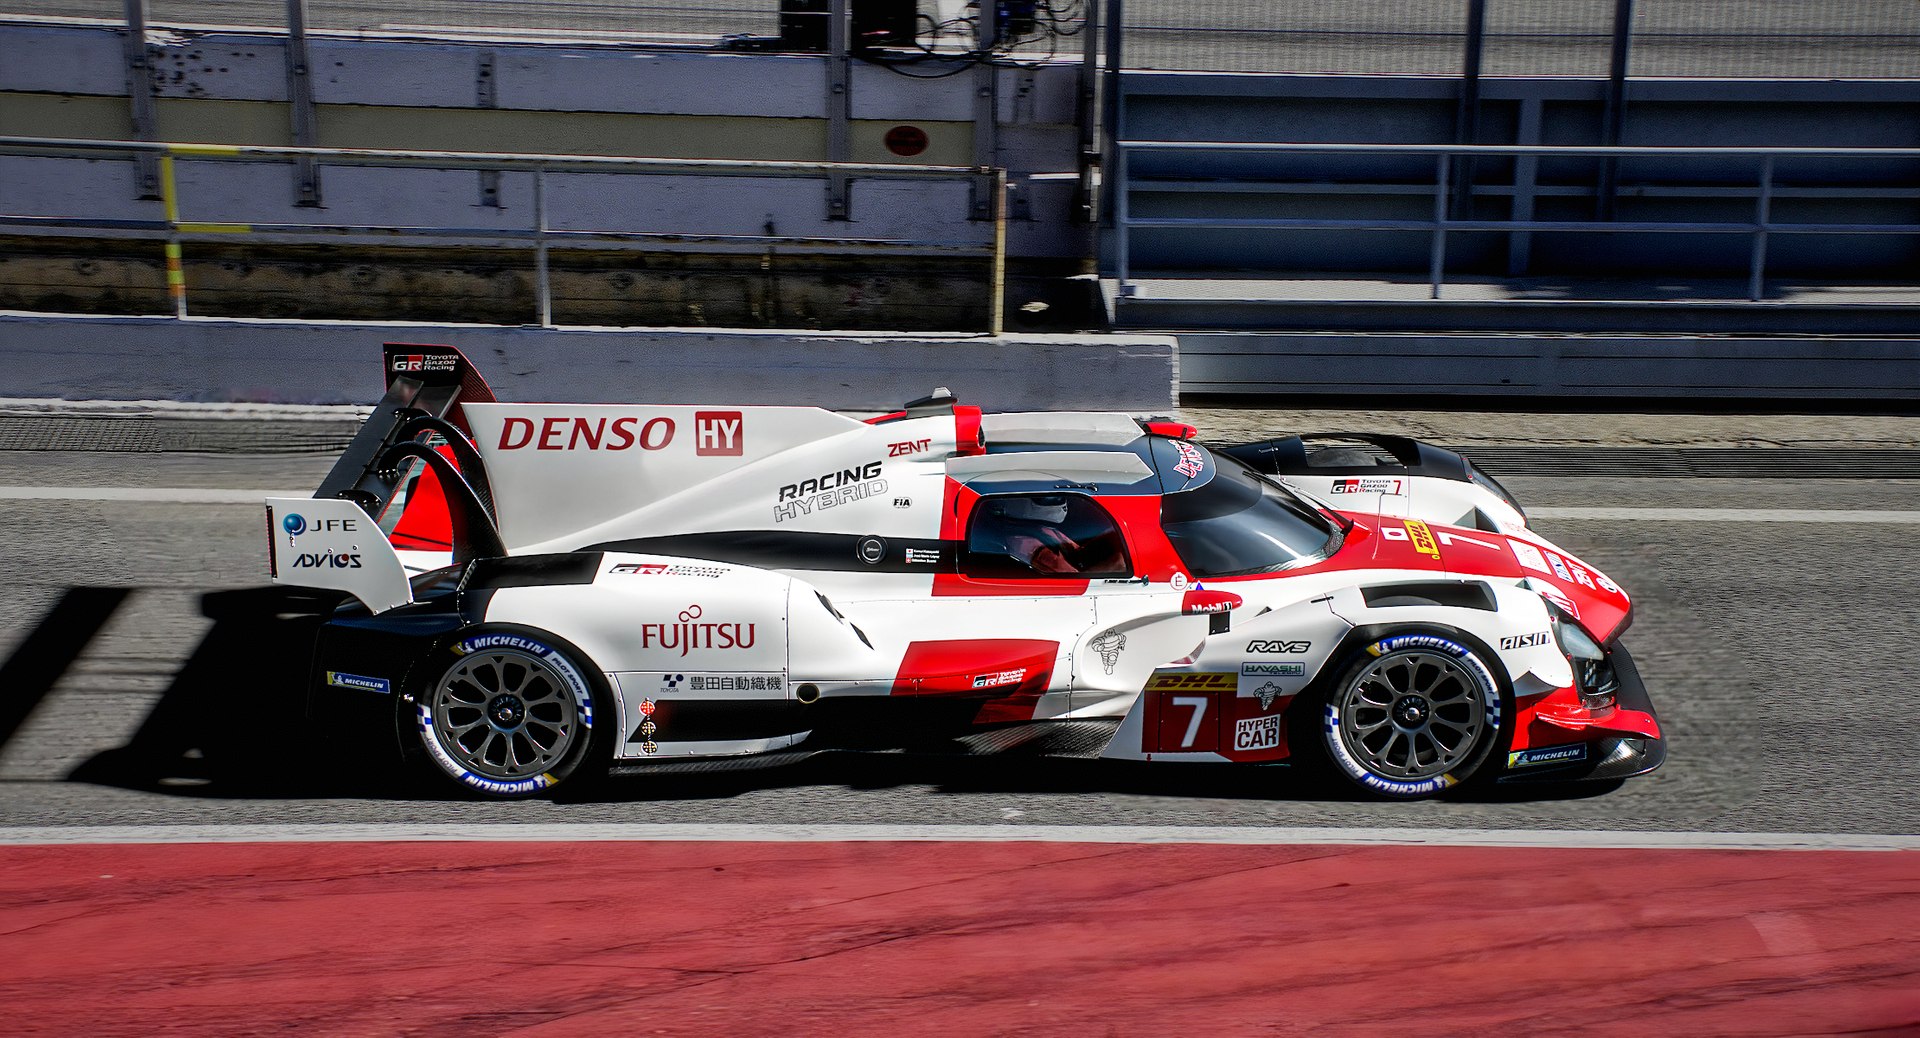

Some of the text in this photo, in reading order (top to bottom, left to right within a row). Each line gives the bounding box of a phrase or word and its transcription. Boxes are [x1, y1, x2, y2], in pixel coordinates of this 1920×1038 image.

[394, 361, 422, 371] GR
[498, 417, 676, 451] DENSO
[699, 419, 740, 449] HY
[887, 438, 931, 457] ZENT
[778, 460, 883, 502] RACING
[1332, 484, 1358, 493] GR
[1394, 480, 1401, 495] 7
[773, 479, 889, 523] HYBRID
[893, 498, 911, 507] FIA
[310, 519, 357, 531] JFE
[474, 636, 545, 654] MICHELIN
[642, 623, 755, 657] FUJITSU
[1247, 640, 1311, 653] RAYS
[1392, 636, 1463, 654] MICHELIN
[1501, 632, 1550, 649] AISIN
[344, 678, 384, 689] MICHELIN
[552, 657, 583, 694] PILOT SPORT
[690, 676, 782, 691] 豊田自動織機
[1154, 674, 1228, 688] DHL
[1467, 658, 1495, 694] PILOT SPORT
[1172, 696, 1208, 748] 7
[1238, 717, 1278, 732] HYPER
[1237, 728, 1277, 749] CAR
[1531, 749, 1580, 761] MICHELIN
[465, 775, 535, 793] MICHELIN
[1366, 776, 1434, 793] MICHELIN
